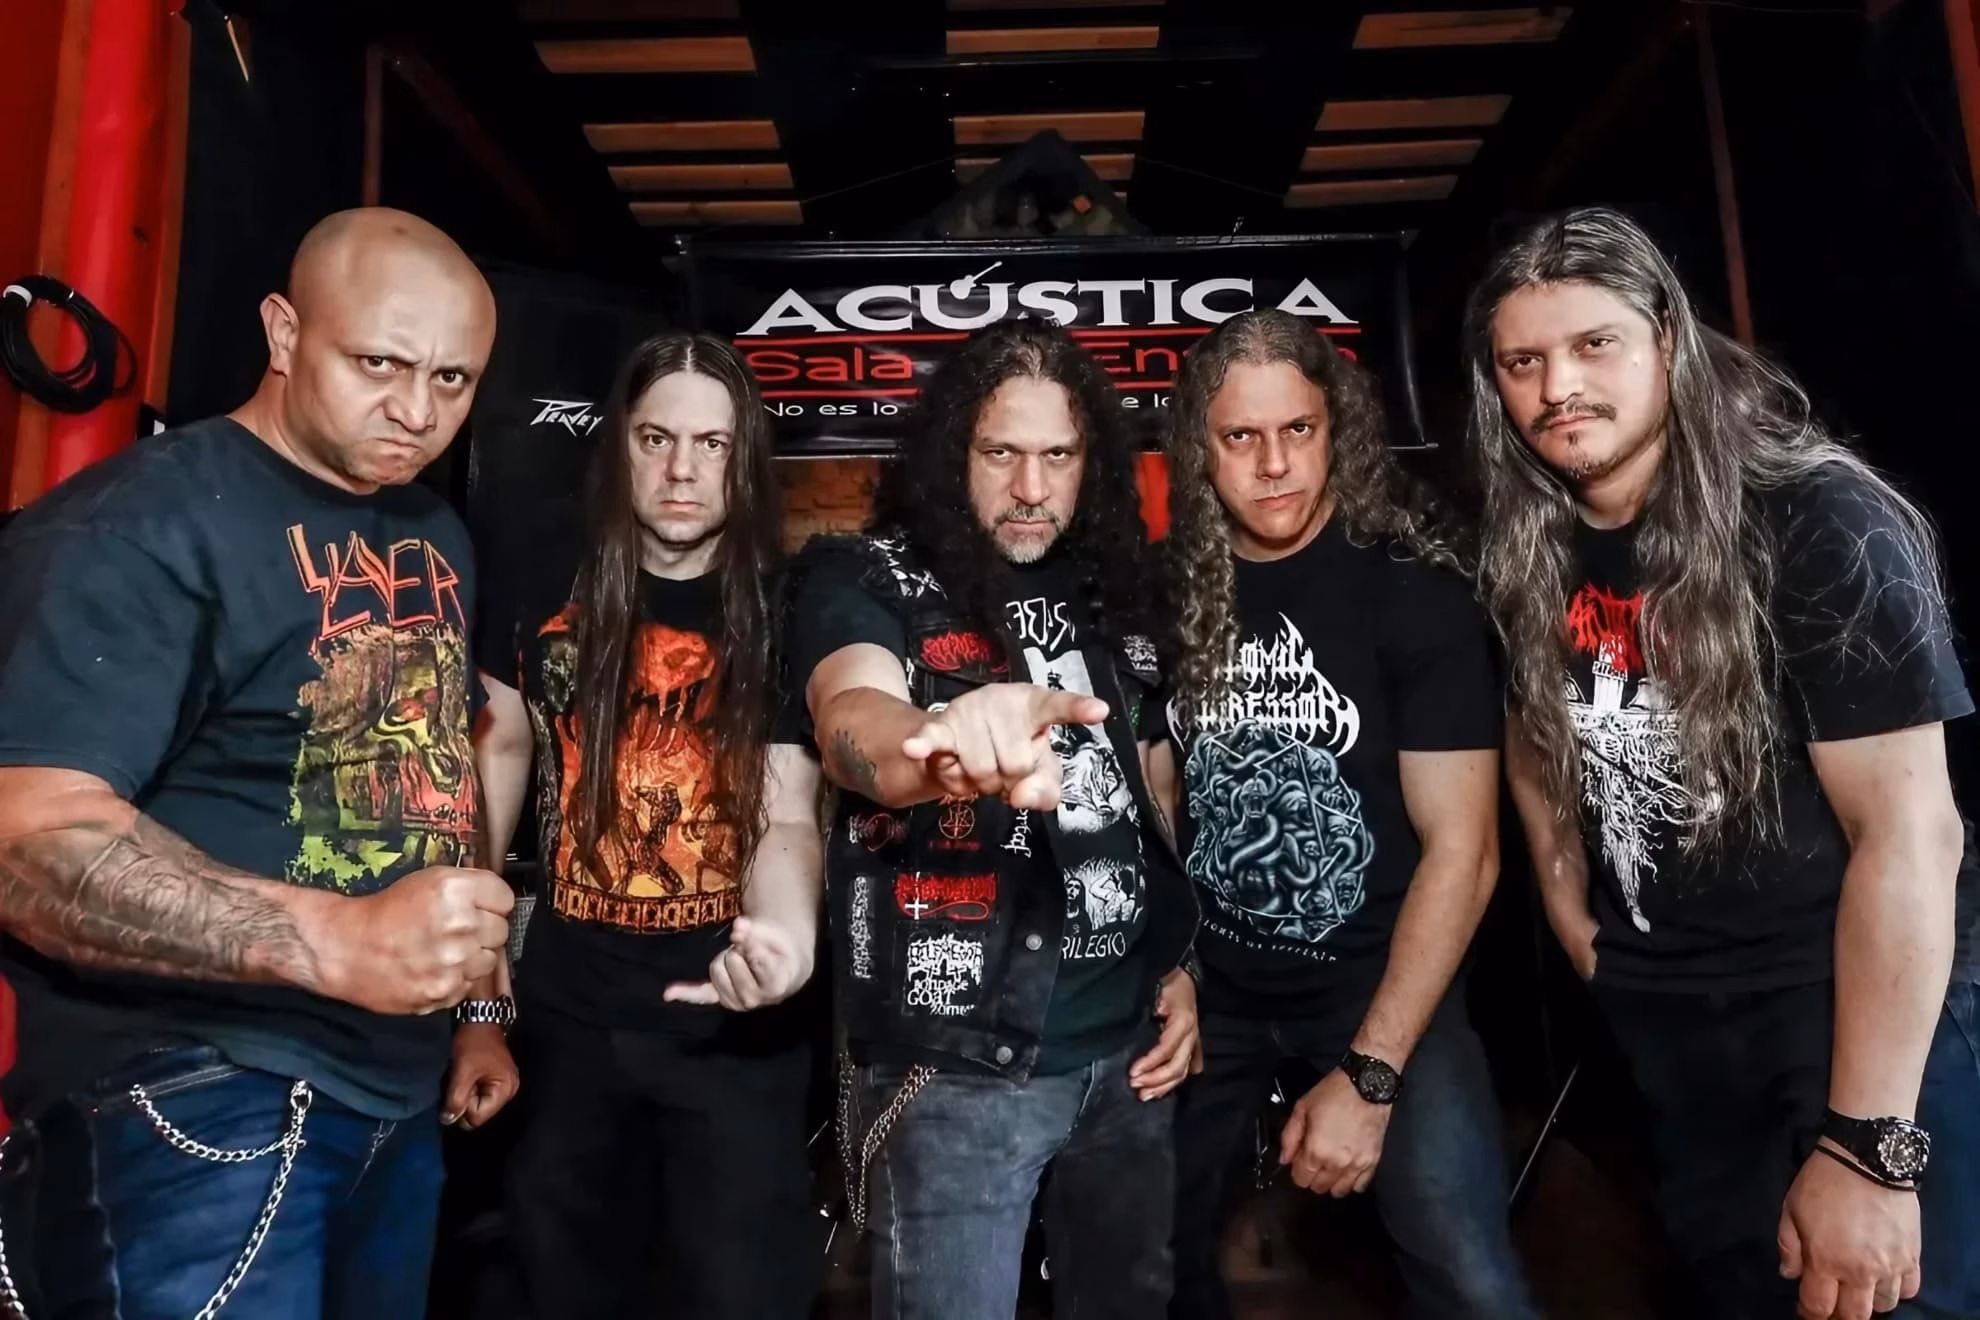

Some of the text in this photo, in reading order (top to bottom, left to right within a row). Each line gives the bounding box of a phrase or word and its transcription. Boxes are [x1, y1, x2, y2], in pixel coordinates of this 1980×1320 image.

[747, 347, 913, 382] Sala
[819, 403, 858, 416] es
[873, 402, 898, 416] lo
[1061, 931, 1126, 960] RILEGIO
